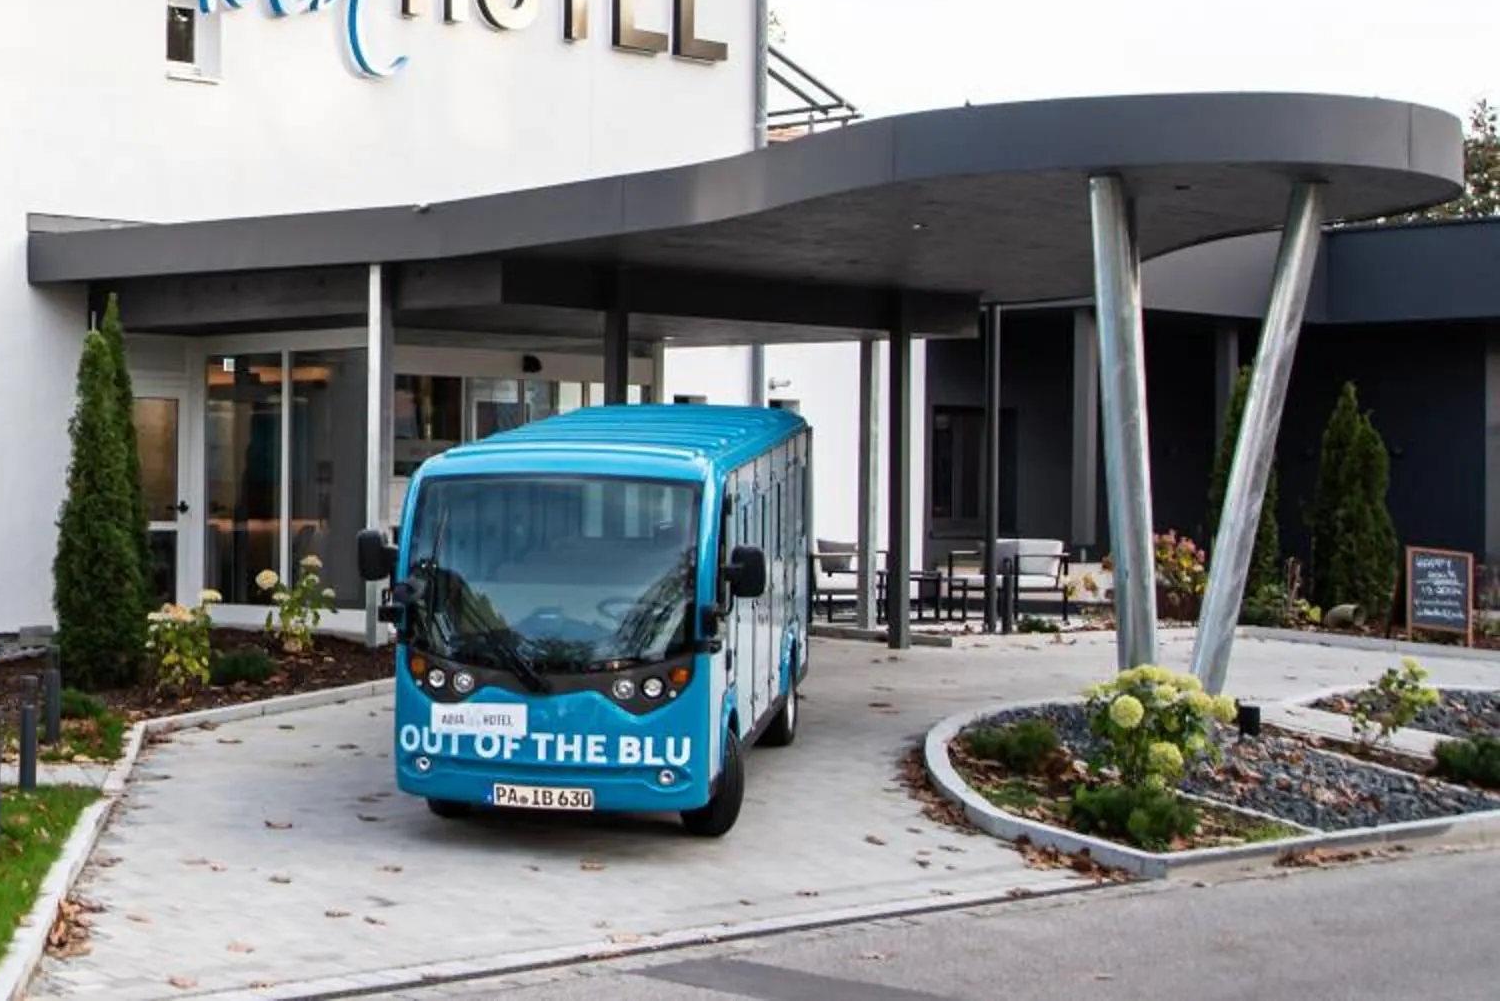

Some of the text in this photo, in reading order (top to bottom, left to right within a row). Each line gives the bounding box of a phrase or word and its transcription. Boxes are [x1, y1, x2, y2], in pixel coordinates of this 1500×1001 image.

[400, 724, 691, 766] OUT OF THE BLU
[558, 790, 592, 808] 630
